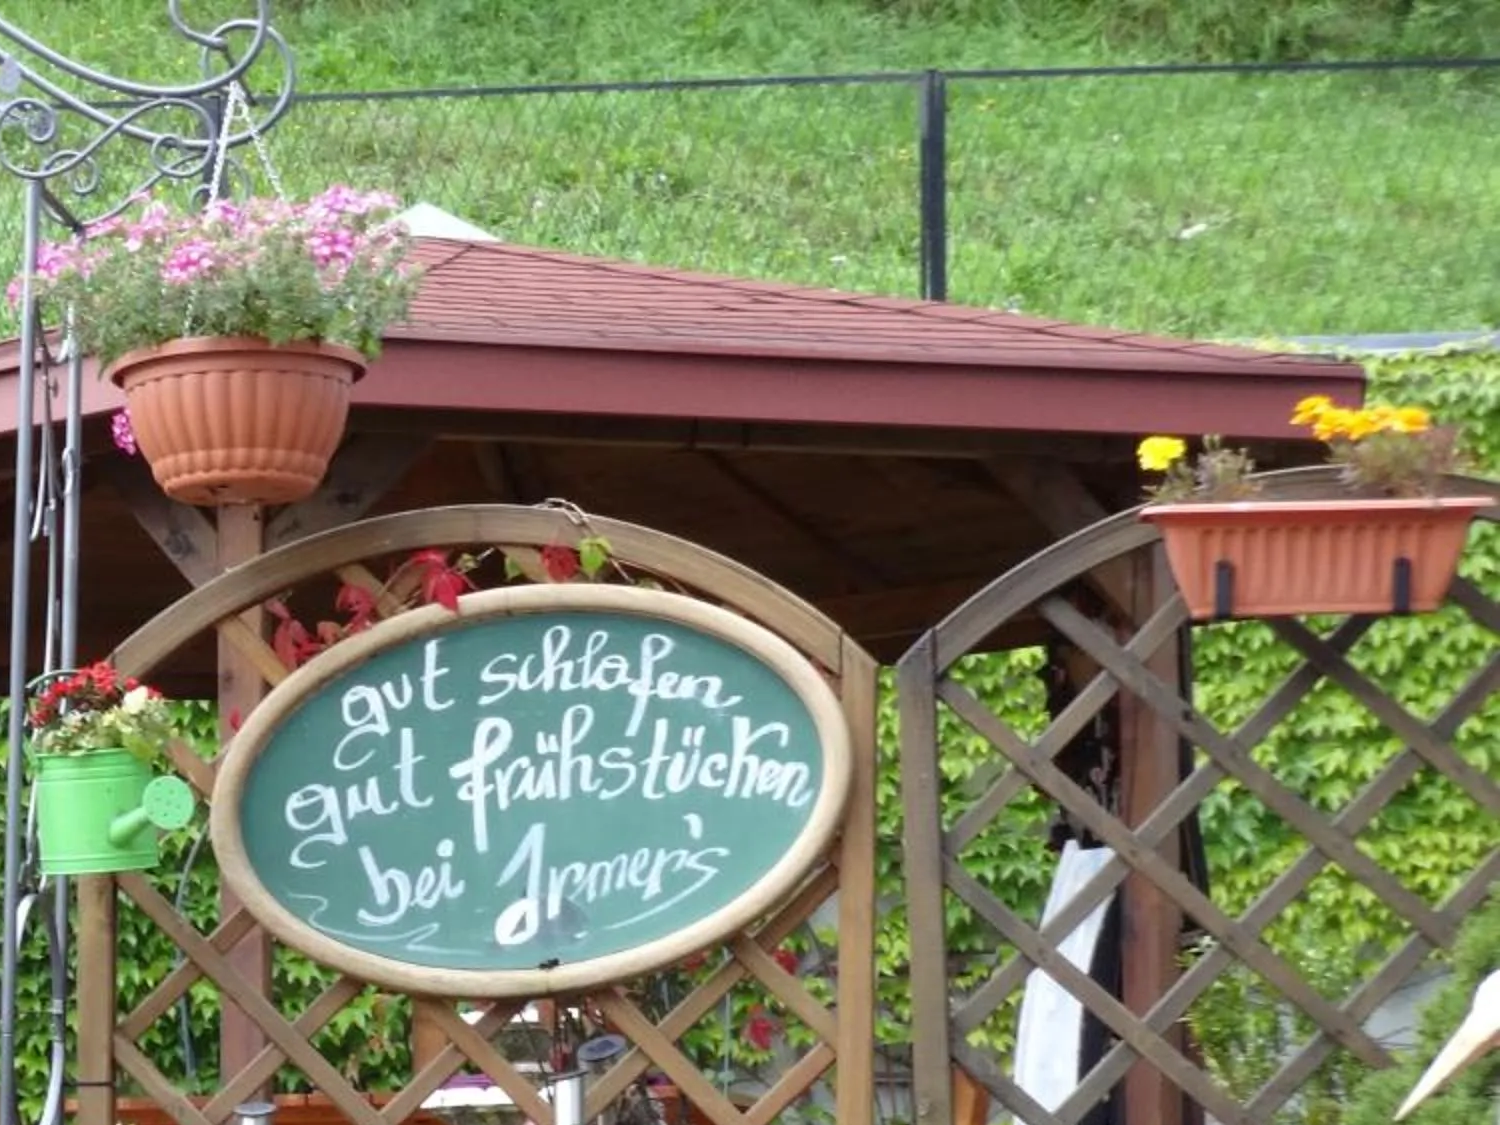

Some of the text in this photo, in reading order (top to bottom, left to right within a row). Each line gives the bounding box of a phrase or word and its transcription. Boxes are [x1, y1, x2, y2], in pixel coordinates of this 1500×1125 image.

[333, 625, 743, 771] gut schlafen
[285, 727, 434, 869] gut
[357, 839, 465, 928] bei
